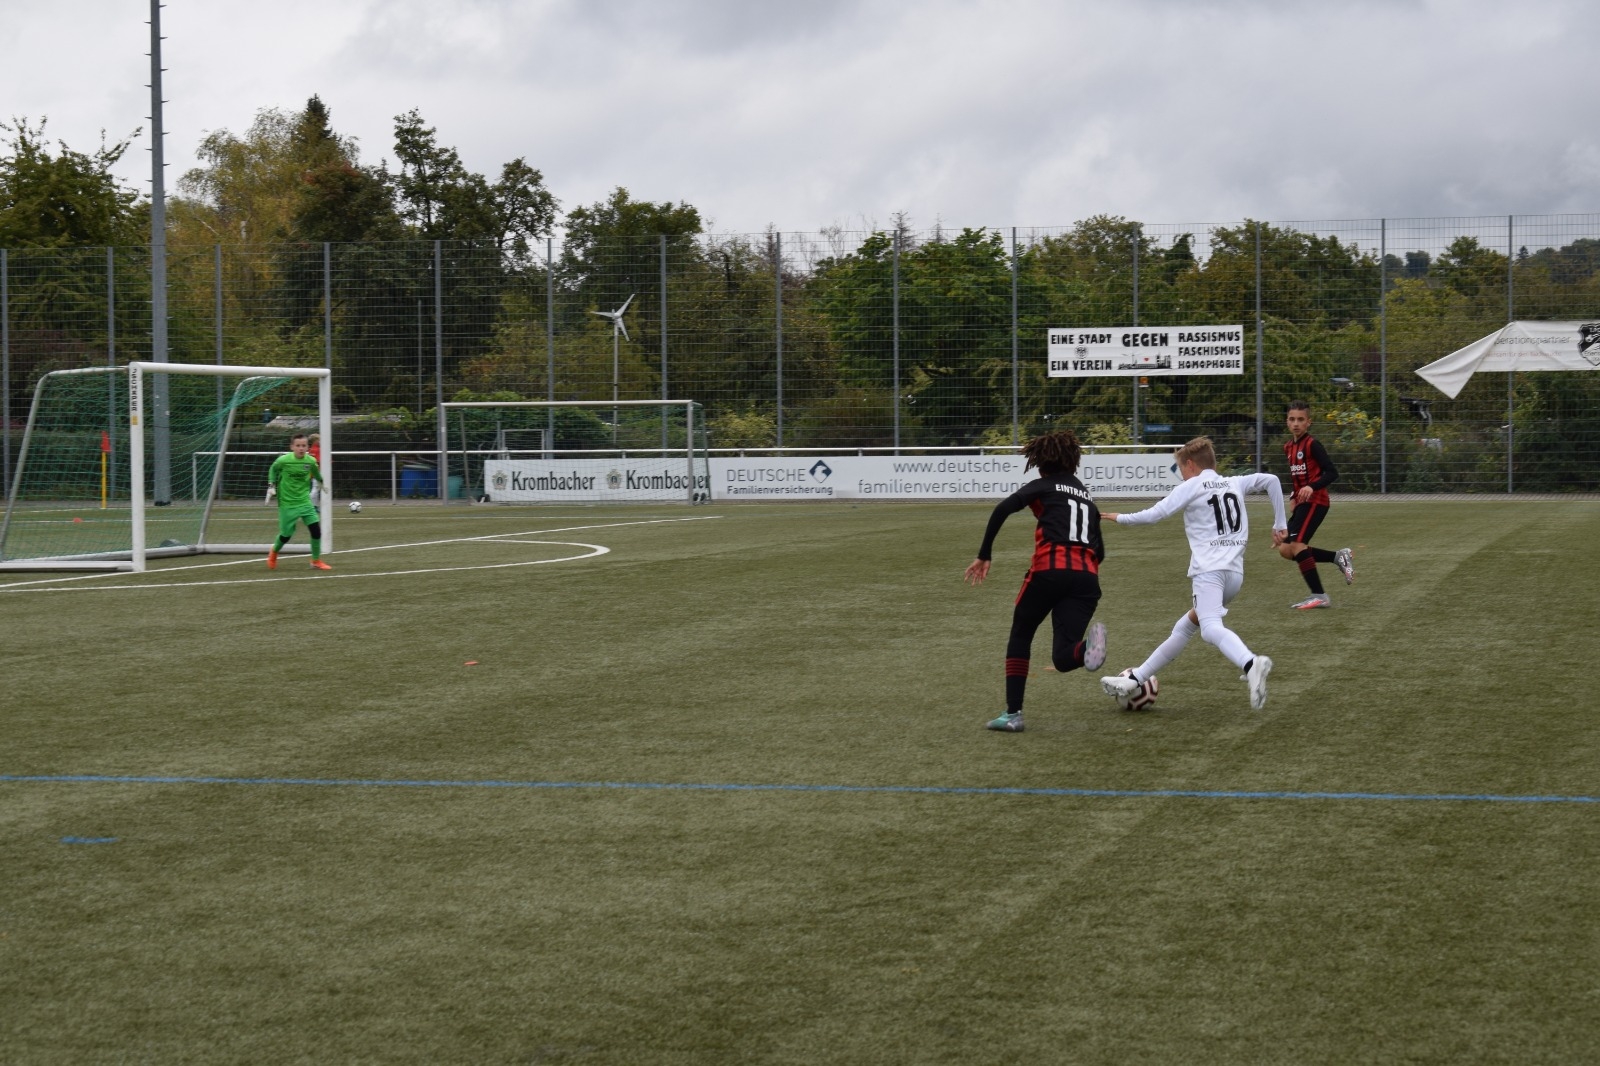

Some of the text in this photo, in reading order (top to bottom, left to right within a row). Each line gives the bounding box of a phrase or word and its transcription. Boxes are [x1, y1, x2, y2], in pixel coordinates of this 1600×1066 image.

[1051, 331, 1240, 347] EINE STADT GEGEN RASSISMUS
[1178, 346, 1241, 356] FASCHISMUS
[1051, 359, 1112, 371] EIN VEREIN
[1178, 359, 1241, 369] HOMOPHOBIE
[893, 458, 1019, 473] www.deutsche-
[1083, 465, 1167, 480] DEUTSCHE
[512, 470, 595, 491] Krombacher
[726, 468, 806, 482] DEUTSCHE
[727, 485, 833, 495] Familienversicherung
[1067, 498, 1090, 544] 11
[1207, 492, 1242, 535] 10
